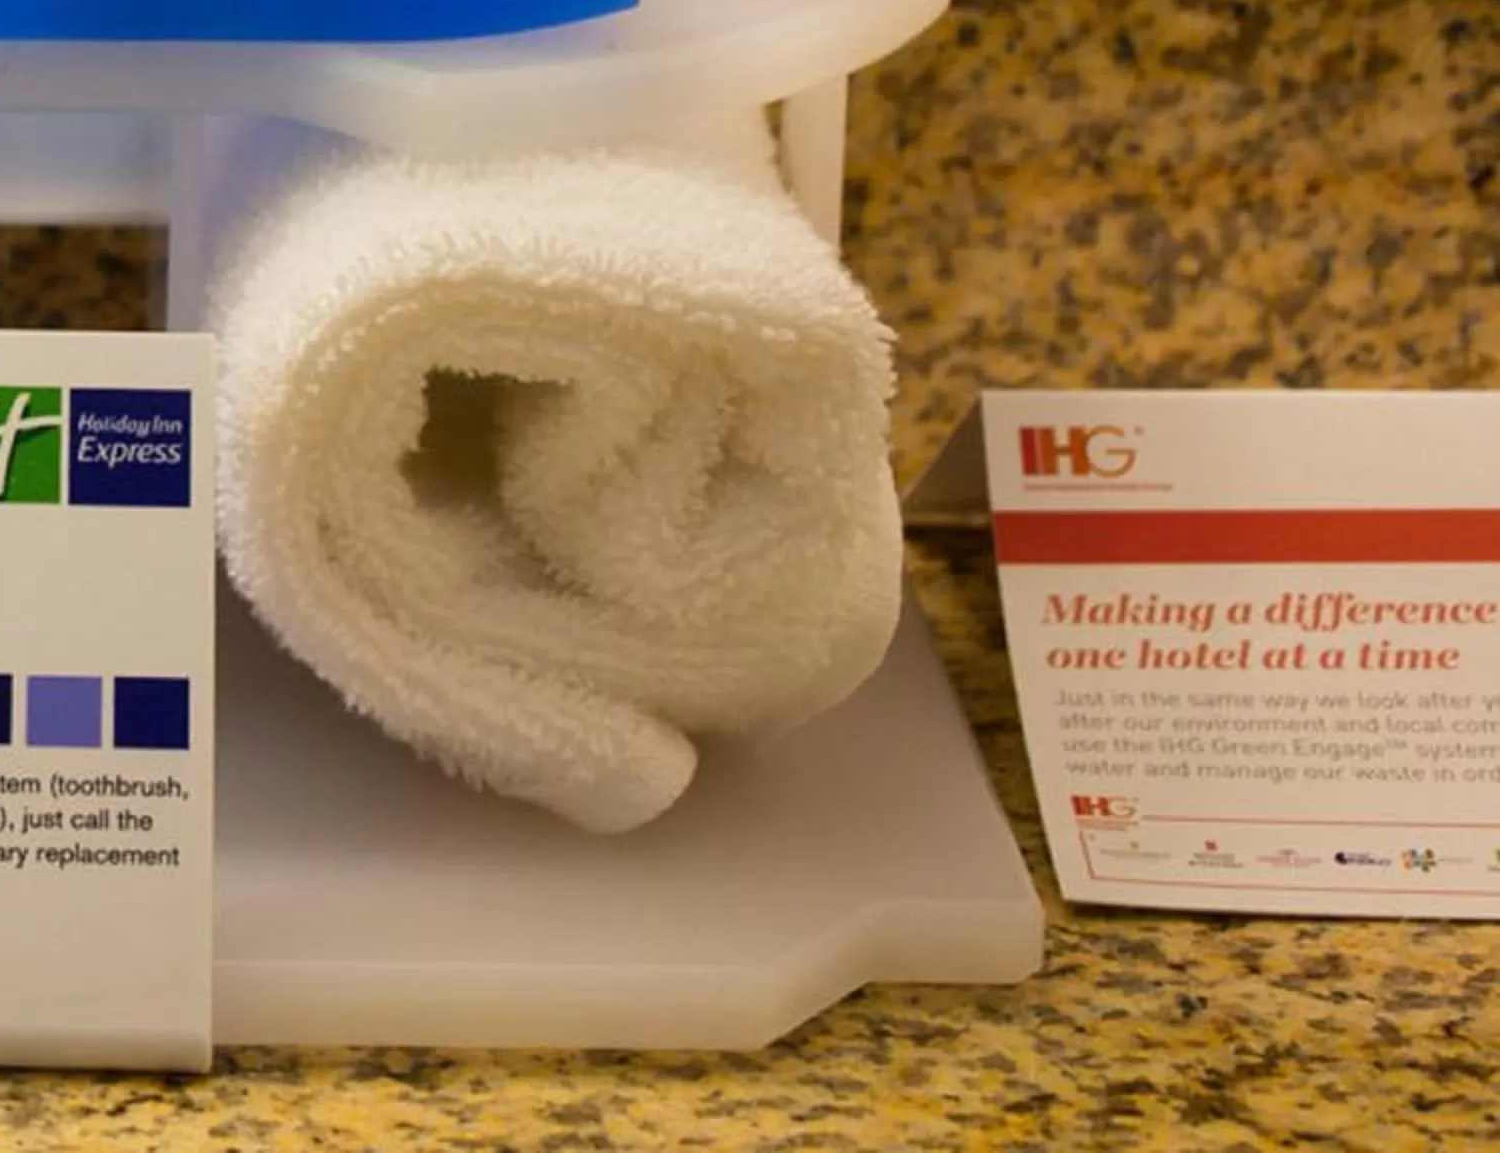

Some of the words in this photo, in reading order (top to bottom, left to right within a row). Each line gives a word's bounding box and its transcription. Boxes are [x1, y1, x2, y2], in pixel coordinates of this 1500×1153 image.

[77, 412, 150, 436] Holiday
[152, 415, 183, 434] Inn
[77, 436, 183, 469] Express
[1042, 593, 1216, 631] Making
[1227, 601, 1252, 625] a
[1264, 592, 1498, 632] difference
[1046, 647, 1127, 670] one
[1138, 639, 1251, 670] hotel
[1262, 641, 1307, 670] at
[1320, 647, 1344, 670] a
[1358, 641, 1461, 671] time
[1056, 689, 1104, 707] Just
[1141, 690, 1181, 707] the
[1188, 694, 1255, 708] same
[1261, 694, 1308, 712] way
[1316, 695, 1349, 708] we
[1357, 690, 1410, 709] look
[1417, 691, 1474, 710] after
[1059, 713, 1113, 730] after
[1123, 717, 1164, 731] our
[1172, 715, 1326, 732] environment
[1336, 716, 1379, 733] and
[1385, 715, 1445, 733] local
[1061, 740, 1107, 753] use
[1112, 738, 1153, 753] the
[1211, 737, 1287, 755] Green
[1065, 759, 1135, 777] water
[1145, 760, 1190, 777] and
[1197, 764, 1299, 784] manage
[1354, 766, 1426, 783] waste
[49, 773, 190, 800] (toothbrush,
[21, 807, 63, 834] just
[70, 808, 109, 830] call
[116, 809, 154, 832] the
[35, 844, 179, 870] replacement
